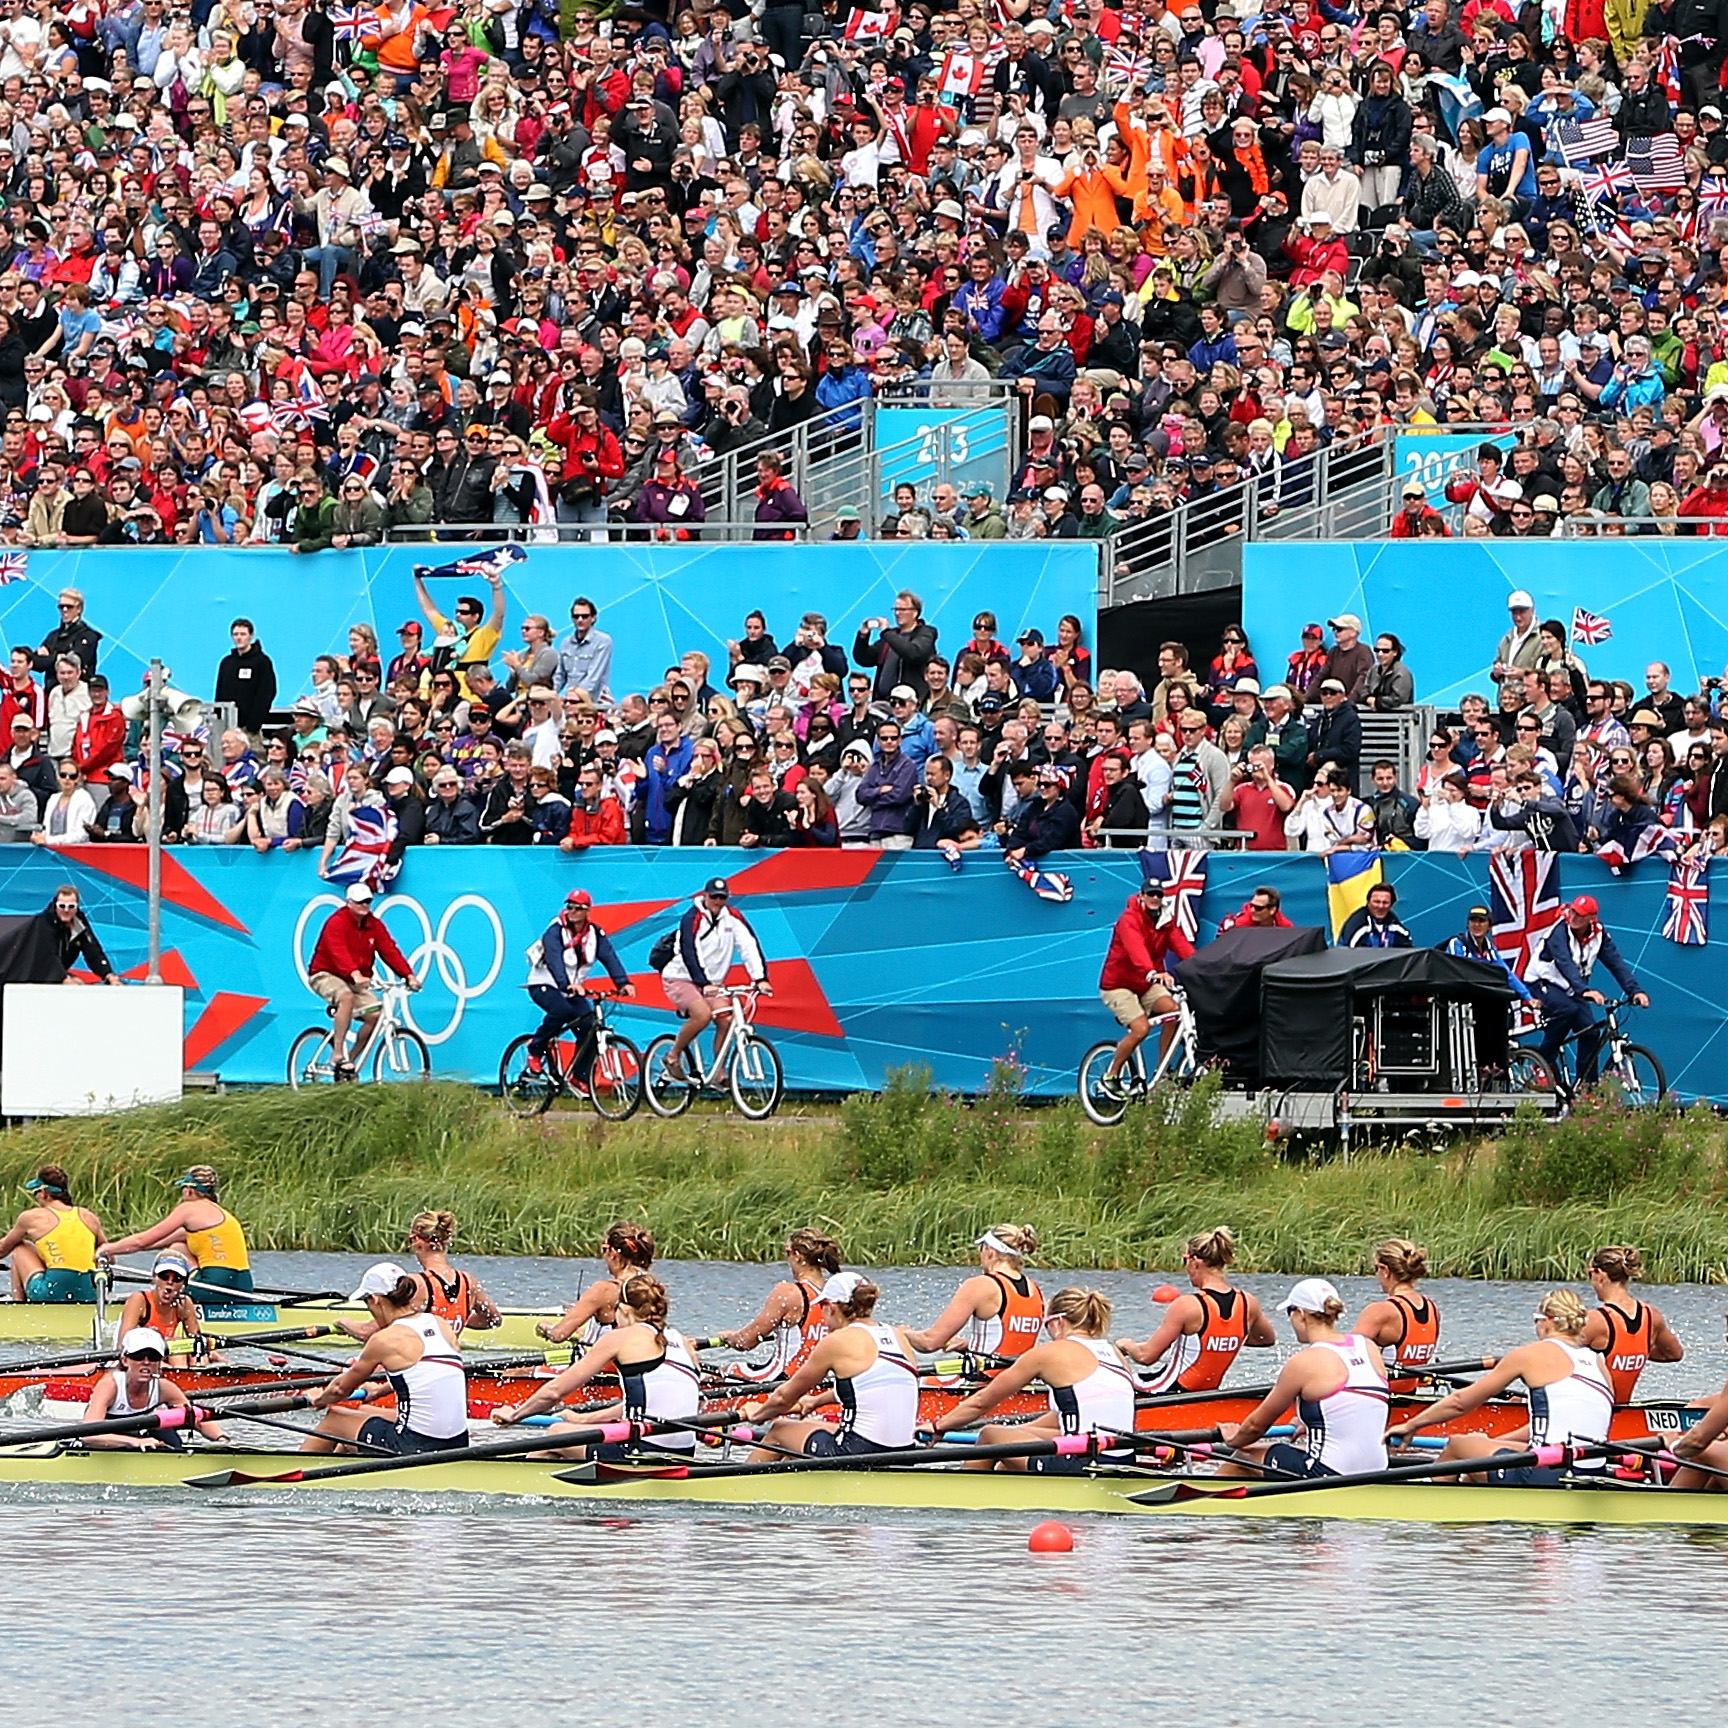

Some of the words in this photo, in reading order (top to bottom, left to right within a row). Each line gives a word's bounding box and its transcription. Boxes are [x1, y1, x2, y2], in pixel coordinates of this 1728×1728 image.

[46, 1241, 65, 1264] AUS
[807, 1323, 829, 1341] NE
[1008, 1315, 1040, 1333] NED
[1206, 1336, 1238, 1352] NED
[1612, 1354, 1645, 1371] NED
[1648, 1412, 1678, 1429] NED
